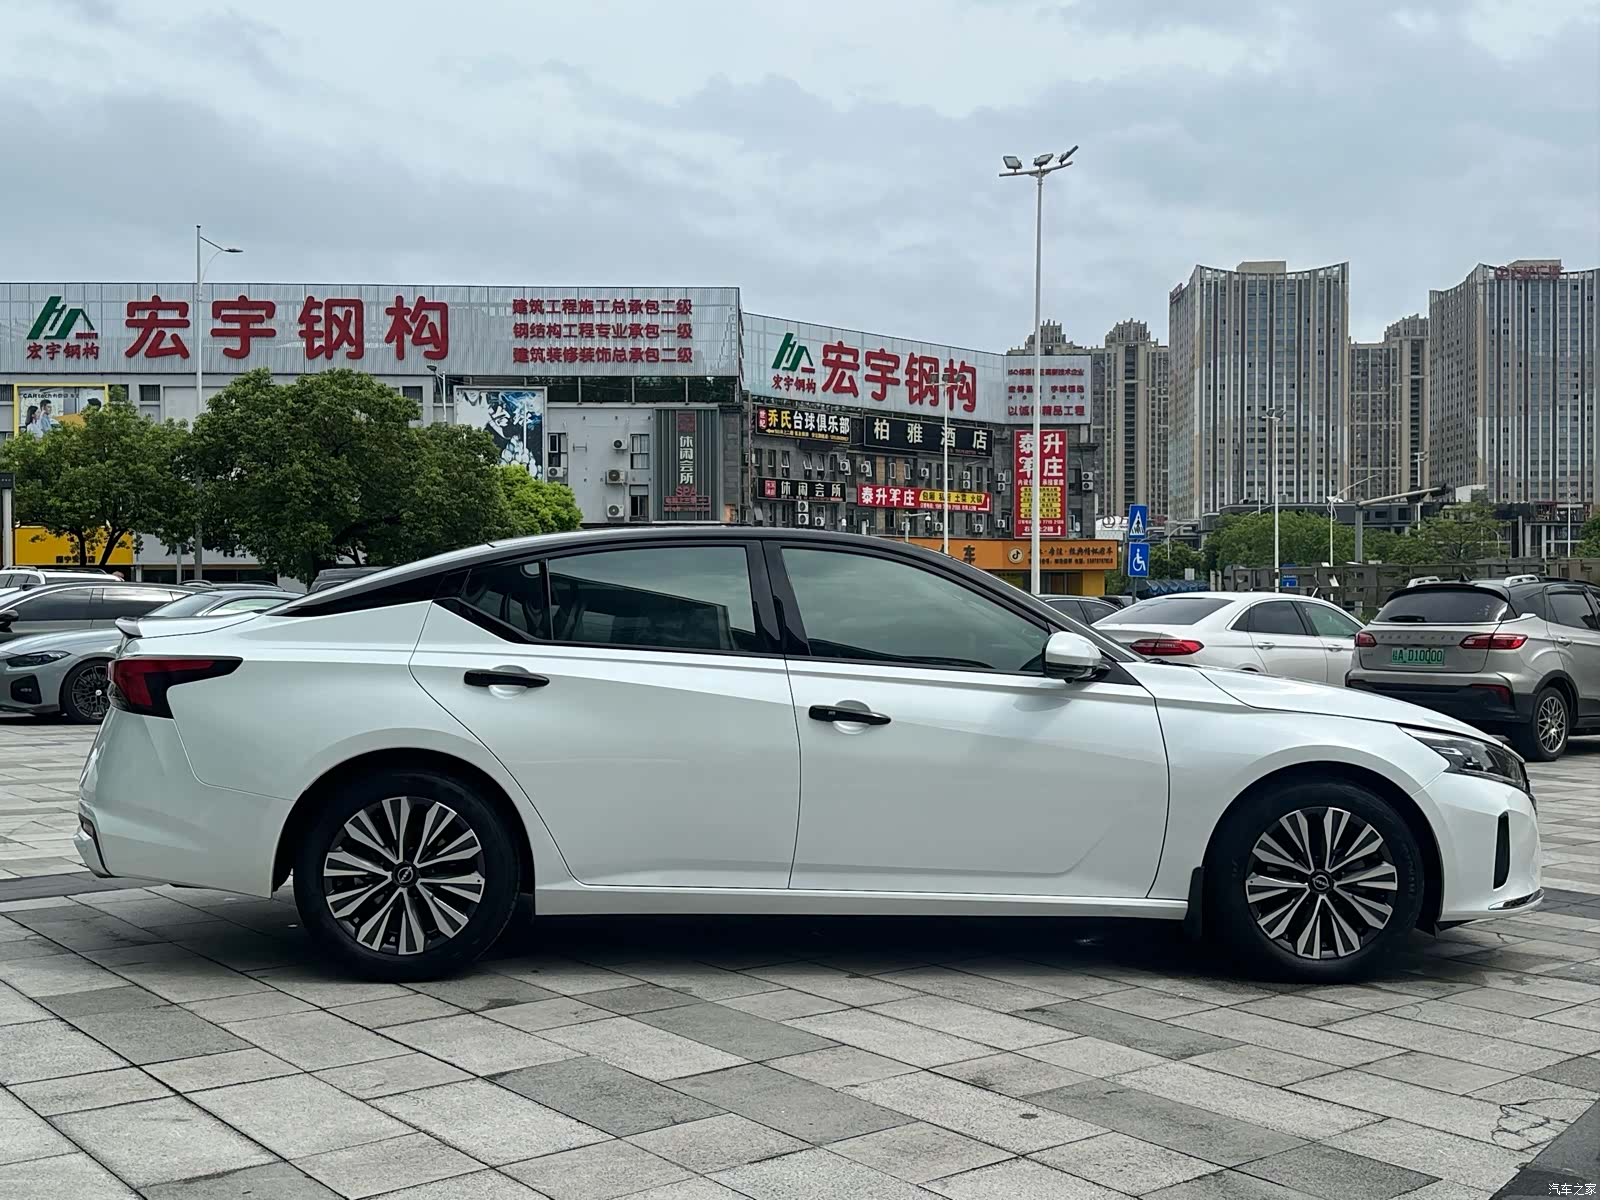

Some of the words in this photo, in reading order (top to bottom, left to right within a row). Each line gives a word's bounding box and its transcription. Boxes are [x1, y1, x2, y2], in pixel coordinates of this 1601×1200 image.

[512, 298, 693, 315] 建筑工程施工总承包二级
[125, 295, 448, 360] 宏宇钢构
[512, 322, 693, 339] 钢结构工程专业承包一级
[26, 342, 99, 360] 宏宇钢构
[512, 347, 693, 363] 建筑装修装饰总承包二级
[771, 374, 817, 395] 宏宇钢构
[822, 341, 976, 413] 宏宇钢构
[1008, 405, 1085, 416] 以诚精品工程
[768, 408, 850, 435] 乔氏台球俱乐部
[873, 418, 988, 450] 柏雅酒店
[679, 435, 694, 484] 休闲会所
[781, 480, 841, 497] 休闲会所
